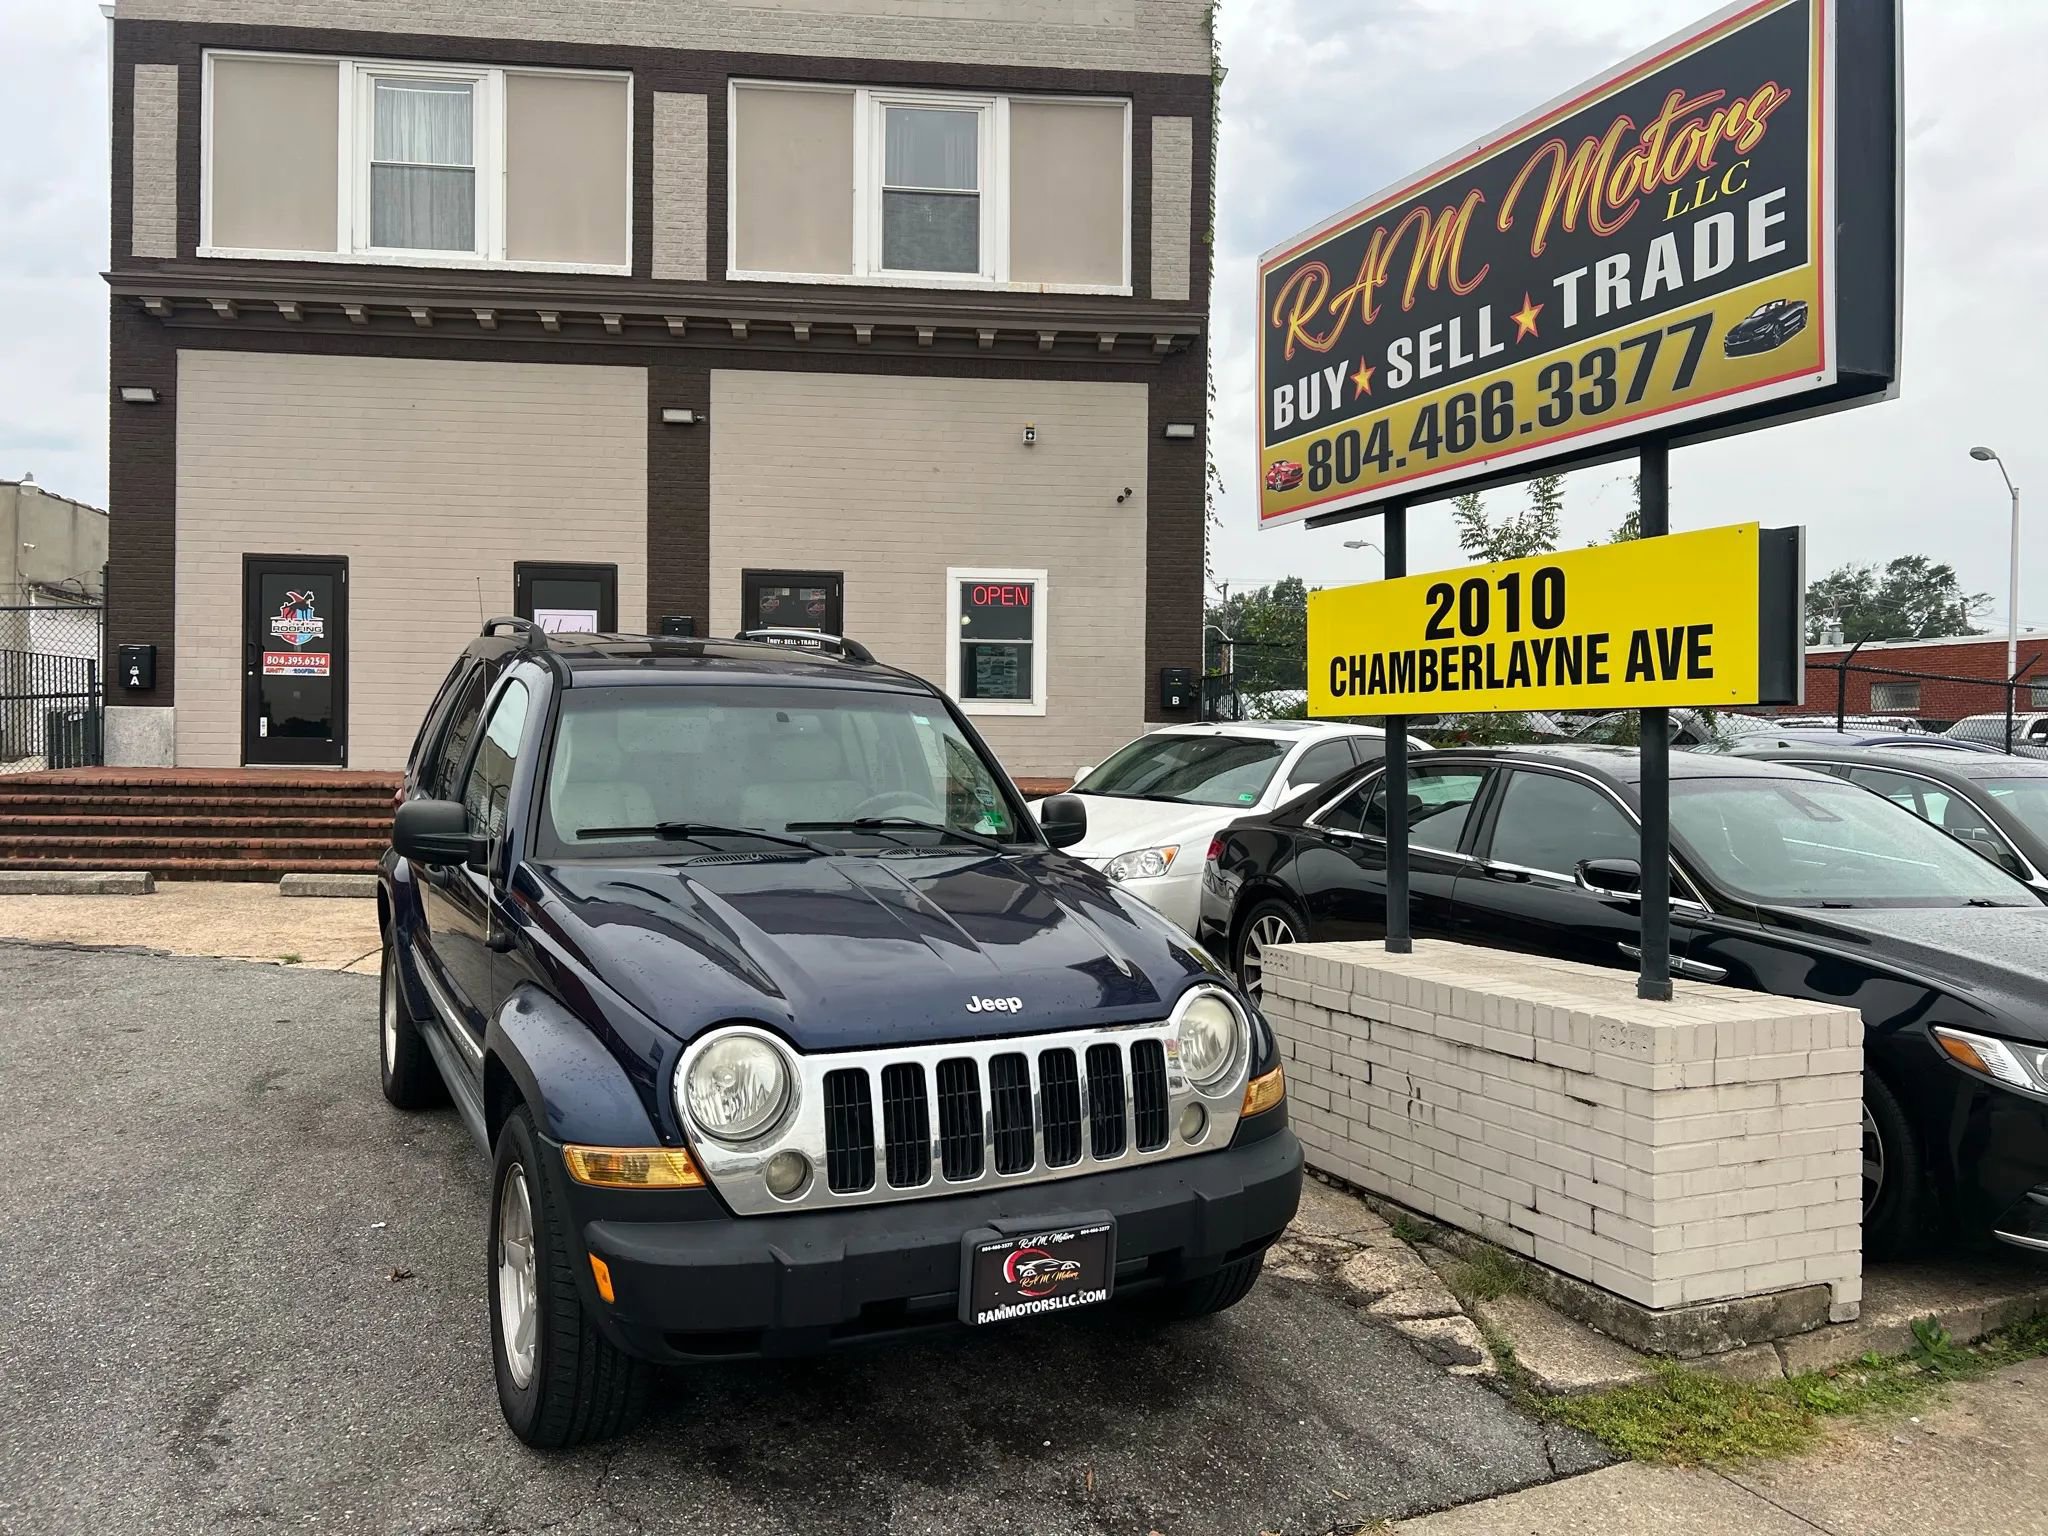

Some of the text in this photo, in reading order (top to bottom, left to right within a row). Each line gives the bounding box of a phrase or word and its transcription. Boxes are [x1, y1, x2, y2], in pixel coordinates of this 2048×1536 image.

[1662, 159, 1750, 222] LLC
[1272, 81, 1791, 360] RAM Motors
[1273, 187, 1787, 431] BUY SELL TRADE
[1307, 311, 1715, 492] 804.466.3377
[973, 586, 1030, 606] OPEN
[1425, 566, 1566, 640] 2010
[266, 655, 326, 665] 804.395.6254
[1330, 623, 1714, 697] CHAMBERLAYNE AVE
[130, 676, 140, 685] A
[1172, 696, 1180, 705] B
[966, 995, 1023, 1014] Jeep
[1018, 1235, 1048, 1249] RAM
[1049, 1232, 1075, 1244] Motors
[1020, 1273, 1050, 1287] RAM
[977, 1288, 1107, 1325] RAMMOTORSLLC.COM
